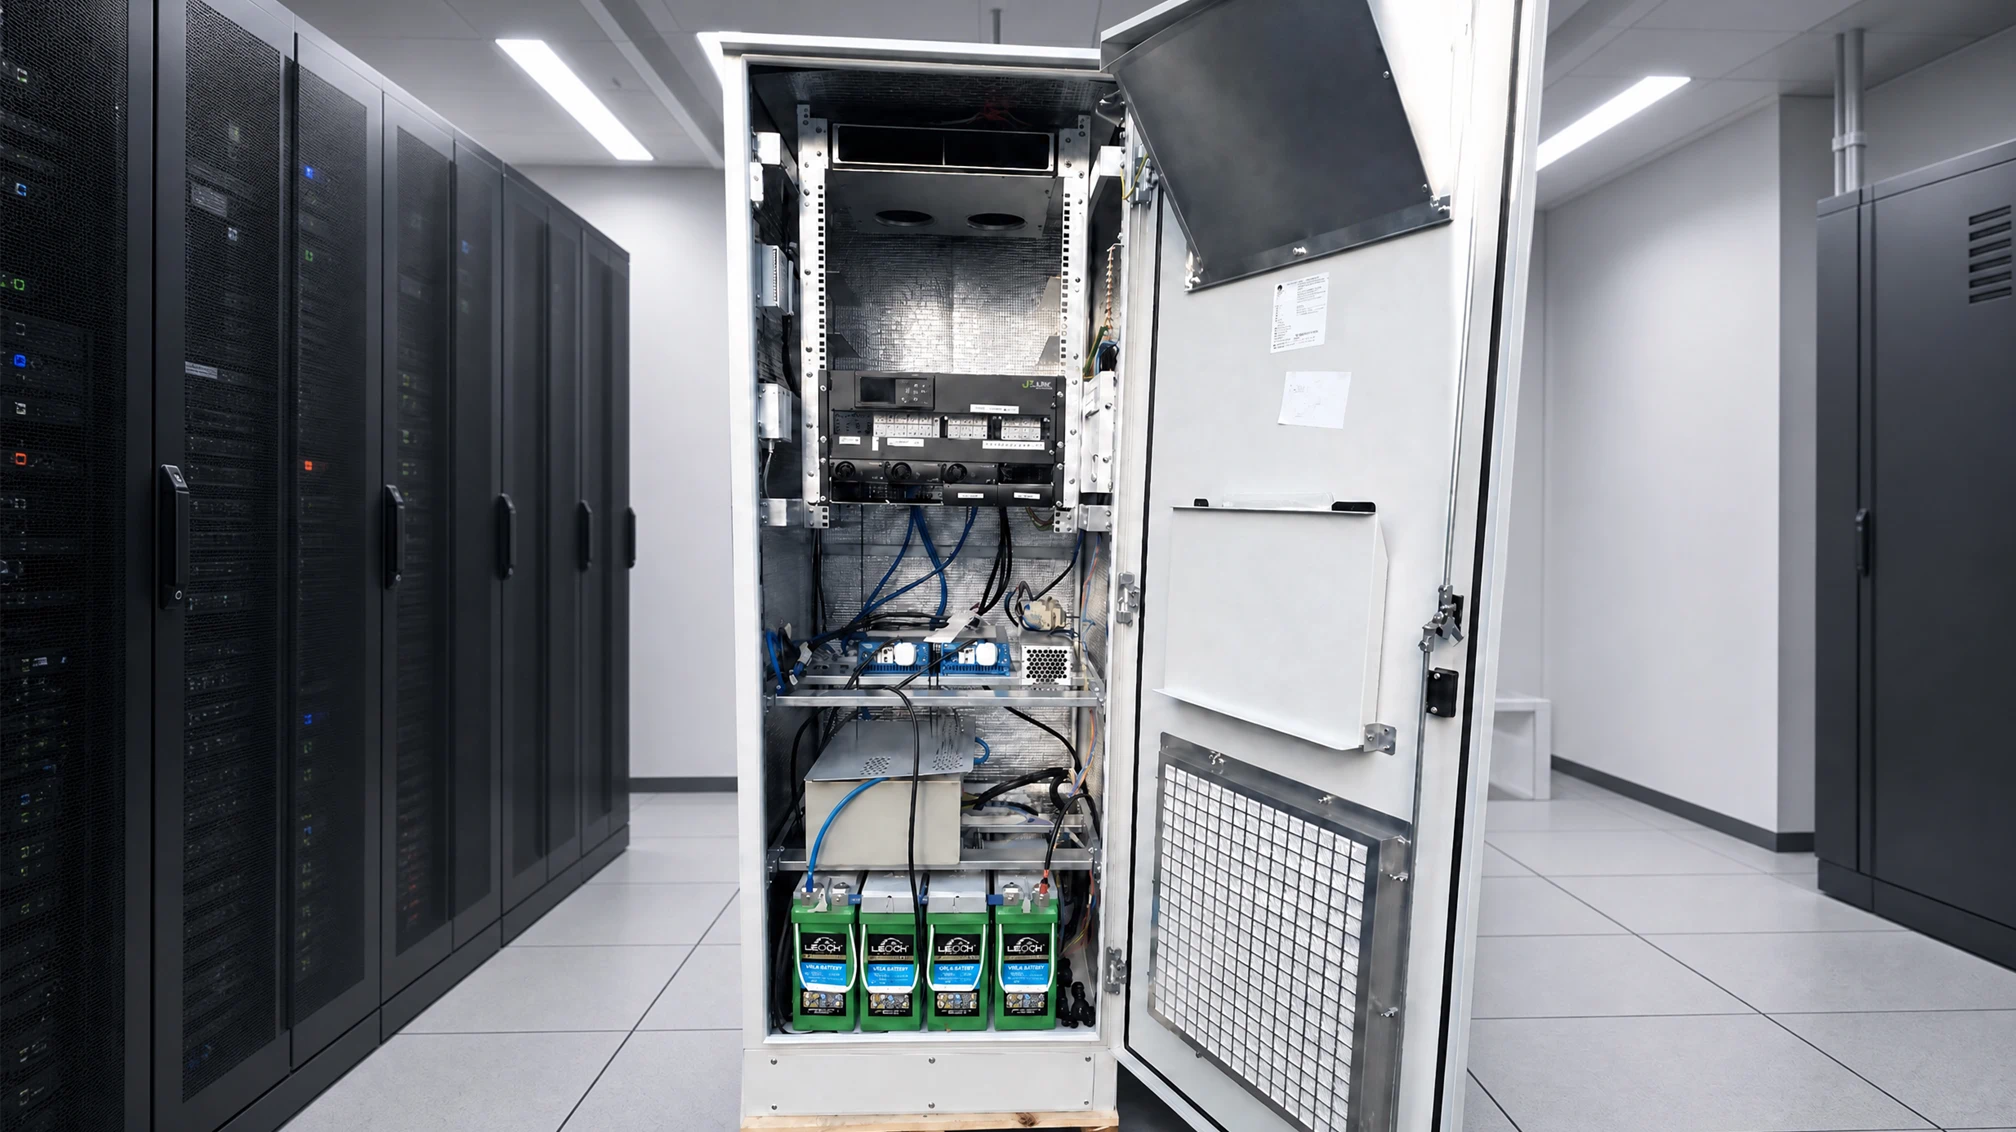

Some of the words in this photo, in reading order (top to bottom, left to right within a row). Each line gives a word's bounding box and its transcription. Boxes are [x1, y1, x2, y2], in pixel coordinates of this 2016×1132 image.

[804, 943, 841, 952] LEOCH
[871, 945, 908, 953] LEOCH
[938, 944, 974, 953] LEOCH
[1007, 944, 1043, 953] LEOCH
